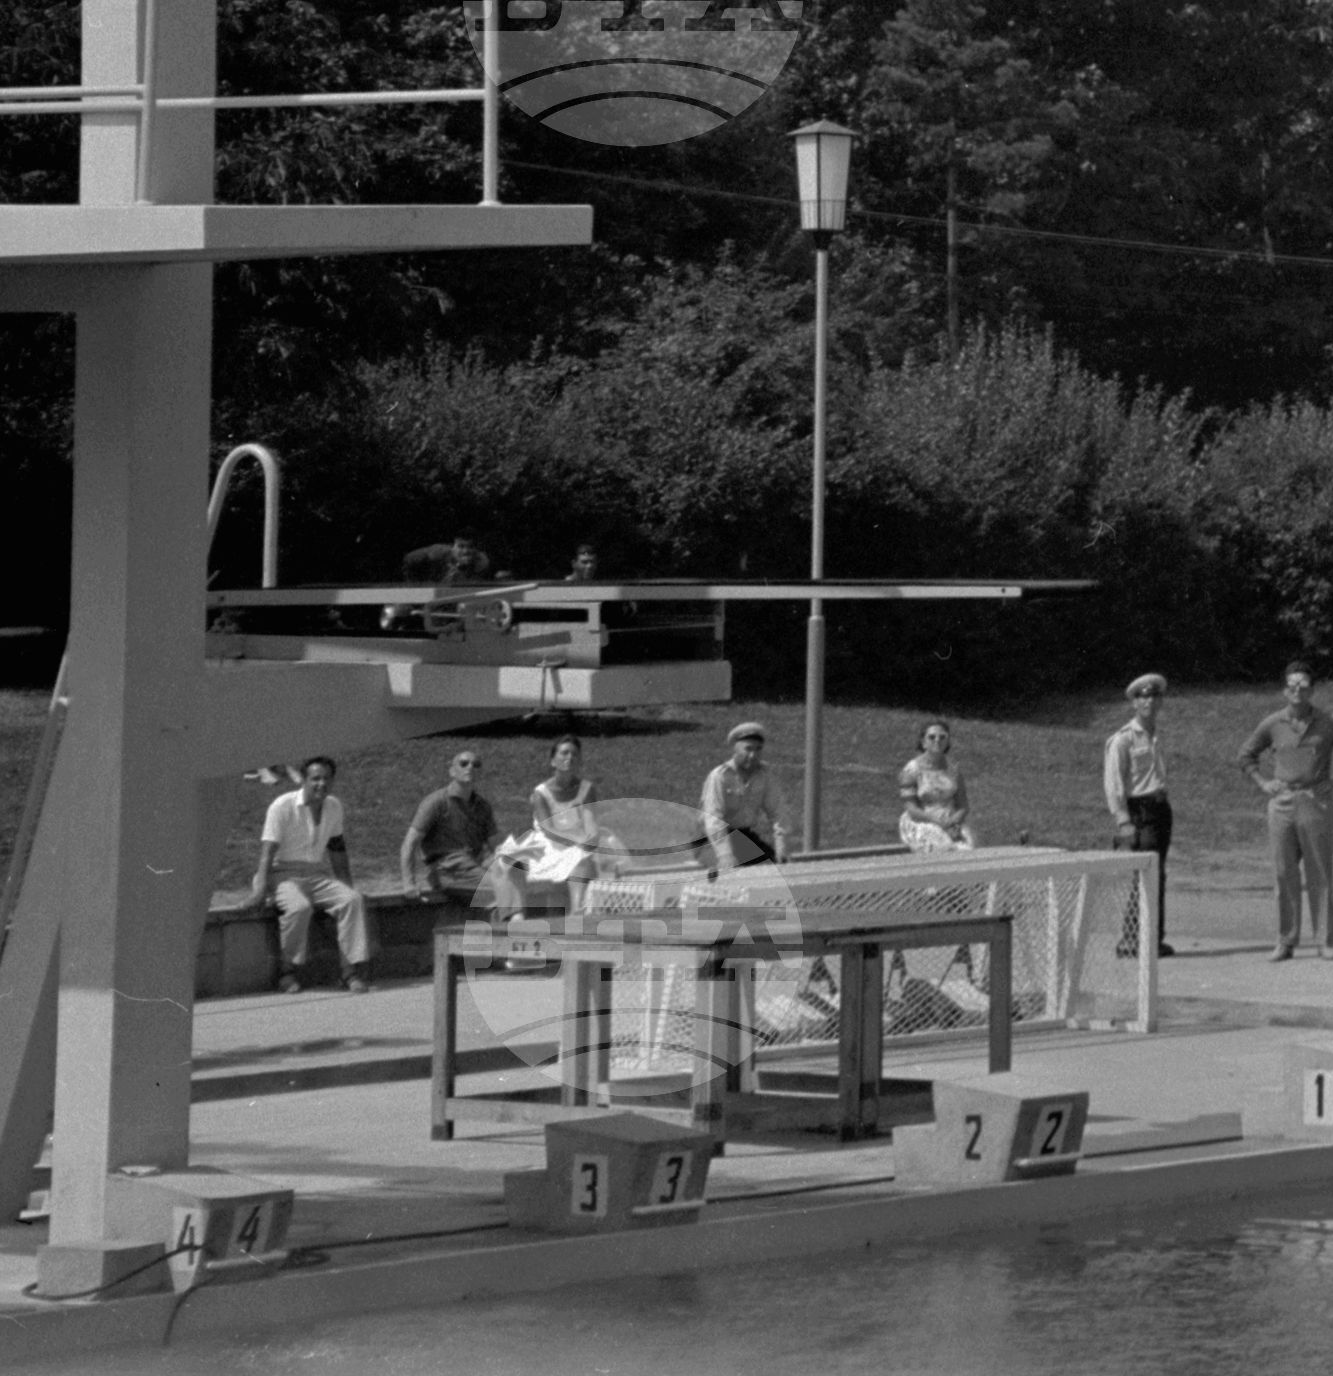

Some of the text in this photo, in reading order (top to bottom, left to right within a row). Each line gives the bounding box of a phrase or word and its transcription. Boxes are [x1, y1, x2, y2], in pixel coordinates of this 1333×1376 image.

[1315, 1073, 1324, 1118] 1
[965, 1114, 982, 1160] 2
[1040, 1110, 1064, 1155] 2
[580, 1162, 598, 1212] 3
[659, 1156, 684, 1203] 3
[177, 1213, 195, 1266] 4
[237, 1205, 262, 1253] 4
